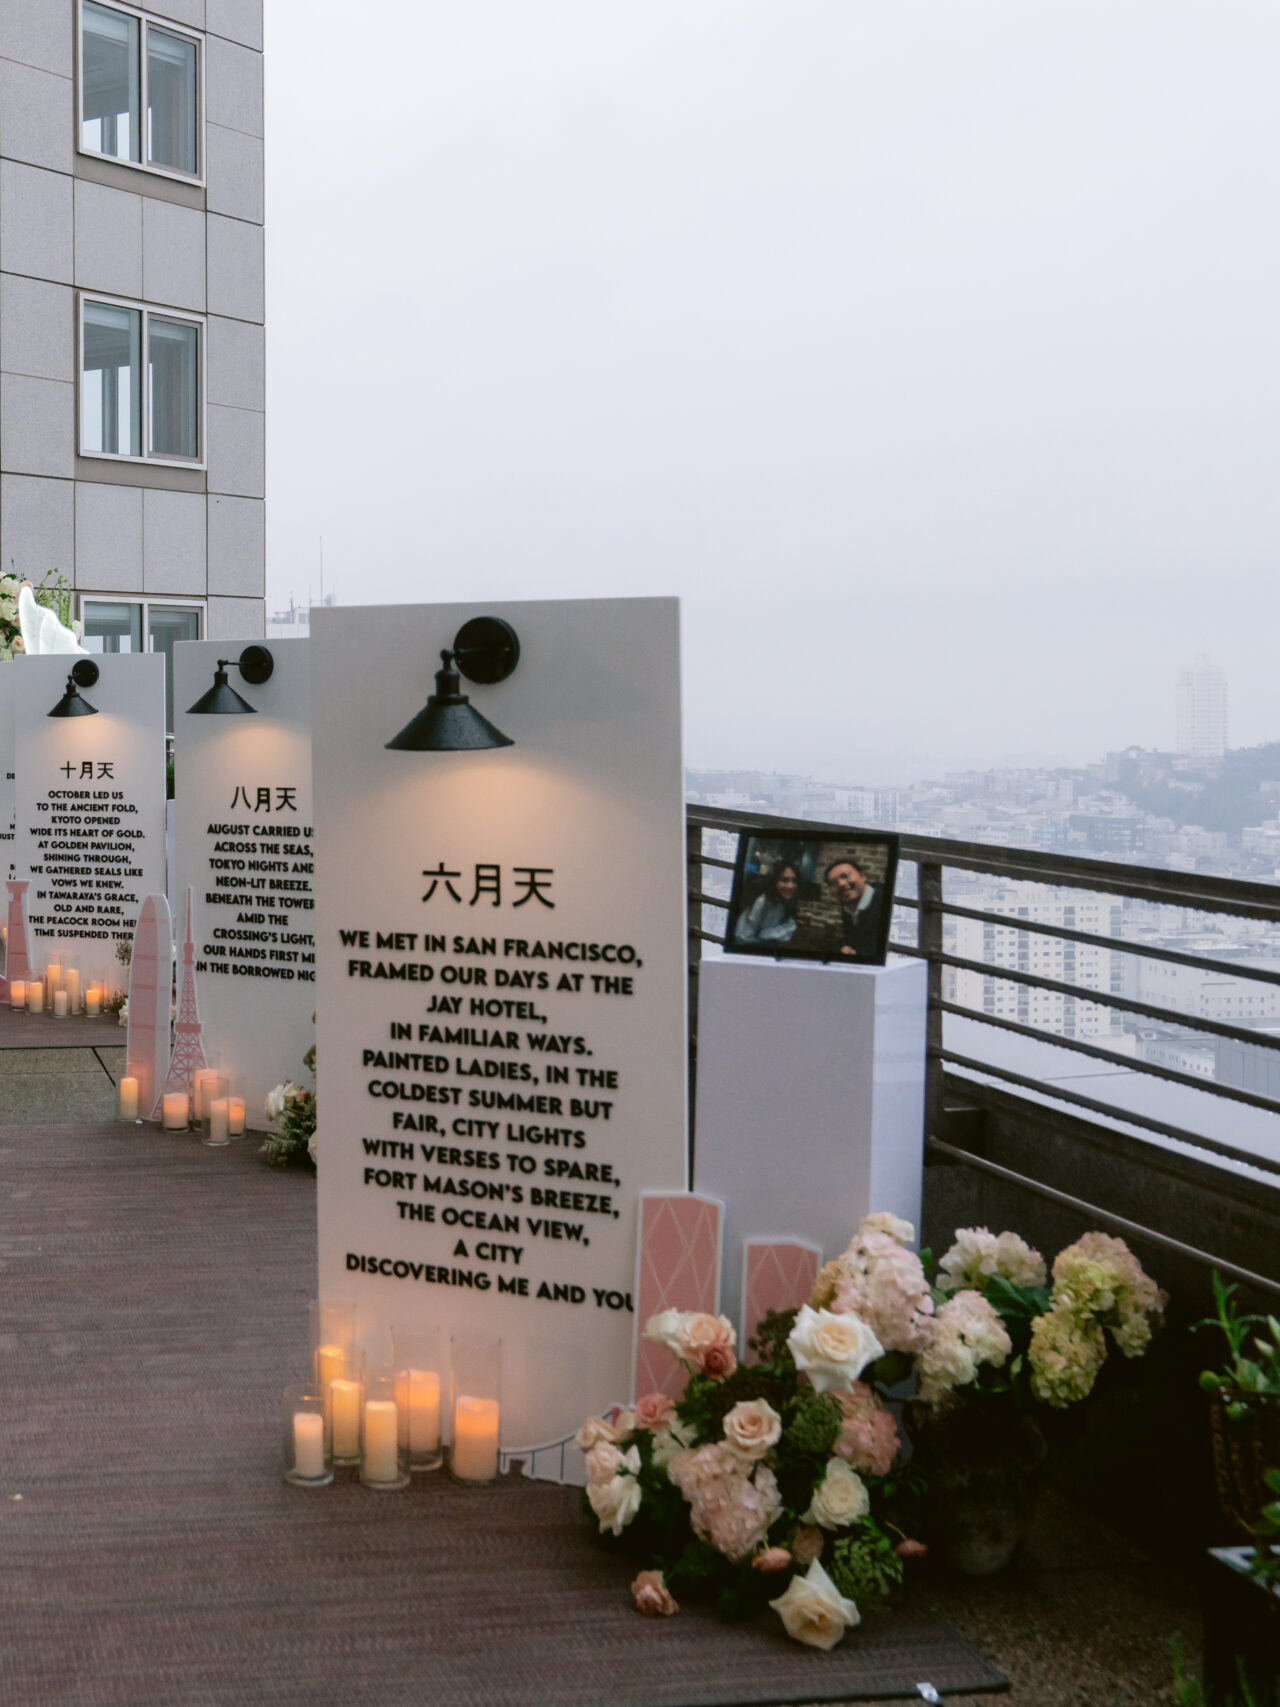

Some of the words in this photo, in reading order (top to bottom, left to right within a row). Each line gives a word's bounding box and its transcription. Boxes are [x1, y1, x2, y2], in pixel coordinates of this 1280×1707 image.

[60, 761, 115, 780] 十月天
[48, 791, 91, 799] OCTOBER
[93, 792, 110, 800] LED
[112, 792, 124, 800] US
[231, 787, 298, 813] 八月天
[37, 803, 50, 812] TO
[51, 803, 68, 812] THE
[70, 804, 110, 812] ANCIENT
[112, 804, 139, 814] FOLD,
[52, 816, 82, 825] KYOTO
[84, 817, 121, 825] OPENED
[30, 828, 53, 837] WIDE
[55, 829, 68, 837] ITS
[70, 829, 100, 838] HEART
[102, 830, 115, 838] OF
[117, 830, 146, 839] GOLD.
[207, 824, 250, 836] AUGUST
[253, 825, 301, 838] CARRIED
[38, 841, 49, 849] AT
[51, 841, 89, 850] GOLDEN
[91, 842, 135, 853] PAVILION,
[214, 842, 258, 854] ACROSS
[260, 843, 281, 855] THE
[283, 844, 314, 858] SEAS,
[44, 854, 82, 863] SHINING
[83, 855, 132, 865] THROUGH,
[209, 858, 246, 871] TOKYO
[249, 861, 289, 873] NIGHTS
[30, 866, 44, 874] WE
[46, 866, 93, 876] GATHERED
[95, 868, 122, 877] SEALS
[124, 869, 144, 877] LIKE
[51, 879, 78, 888] VOWS
[80, 880, 94, 888] WE
[96, 881, 124, 889] KNEW.
[216, 876, 267, 890] NEON-LIT
[270, 879, 313, 892] BREEZE.
[421, 861, 556, 910] 六月天
[37, 891, 47, 899] IN
[49, 891, 103, 901] TAWARAYA'S
[104, 893, 139, 904] GRACE,
[206, 893, 253, 906] BENEATH
[256, 896, 276, 908] THE
[54, 904, 73, 913] OLD
[75, 905, 95, 914] AND
[97, 906, 125, 916] RARE,
[29, 916, 45, 924] THE
[47, 917, 89, 926] PEACOCK
[92, 918, 121, 927] ROOM
[237, 913, 266, 925] AMID
[268, 914, 289, 926] THE
[35, 928, 55, 937] TIME
[58, 930, 109, 940] SUSPENDED
[213, 928, 278, 943] CROSSING'S
[281, 933, 316, 947] LIGHT,
[204, 945, 227, 957] OUR
[229, 947, 267, 960] HANDS
[270, 950, 300, 963] FIRST
[338, 929, 370, 949] WE
[375, 931, 419, 951] MET
[424, 934, 446, 953] IN
[452, 935, 497, 956] SAN
[503, 938, 643, 969] FRANCISCO,
[196, 961, 208, 972] IN
[210, 963, 230, 975] THE
[232, 964, 295, 980] BORROWED
[348, 959, 435, 983] FRAMED
[439, 965, 488, 987] OUR
[494, 968, 550, 990] DAYS
[556, 972, 585, 993] AT
[590, 974, 634, 996] THE
[426, 994, 464, 1015] JAY
[469, 997, 548, 1025] HOTEL,
[390, 1021, 412, 1041] IN
[418, 1024, 521, 1051] FAMILIAR
[526, 1032, 593, 1057] WAYS.
[362, 1049, 450, 1074] PAINTED
[455, 1057, 540, 1086] LADIES,
[545, 1065, 569, 1085] IN
[575, 1067, 619, 1090] THE
[367, 1079, 463, 1106] COLDEST
[468, 1089, 564, 1116] SUMMER
[569, 1098, 614, 1121] BUT
[392, 1111, 447, 1138] FAIR,
[451, 1117, 500, 1140] CITY
[506, 1123, 587, 1149] LIGHTS
[361, 1137, 415, 1161] WITH
[420, 1143, 501, 1171] VERSES
[505, 1153, 537, 1175] TO
[543, 1158, 621, 1188] SPARE,
[363, 1167, 418, 1191] FORT
[423, 1174, 524, 1204] MASON'S
[530, 1187, 620, 1220] BREEZE,
[396, 1200, 436, 1224] THE
[441, 1207, 520, 1234] OCEAN
[526, 1217, 590, 1247] VIEW,
[453, 1238, 470, 1258] A
[475, 1241, 524, 1265] CITY
[346, 1253, 492, 1291] DISCOVERING
[497, 1274, 530, 1297] ME
[535, 1280, 587, 1305] AND
